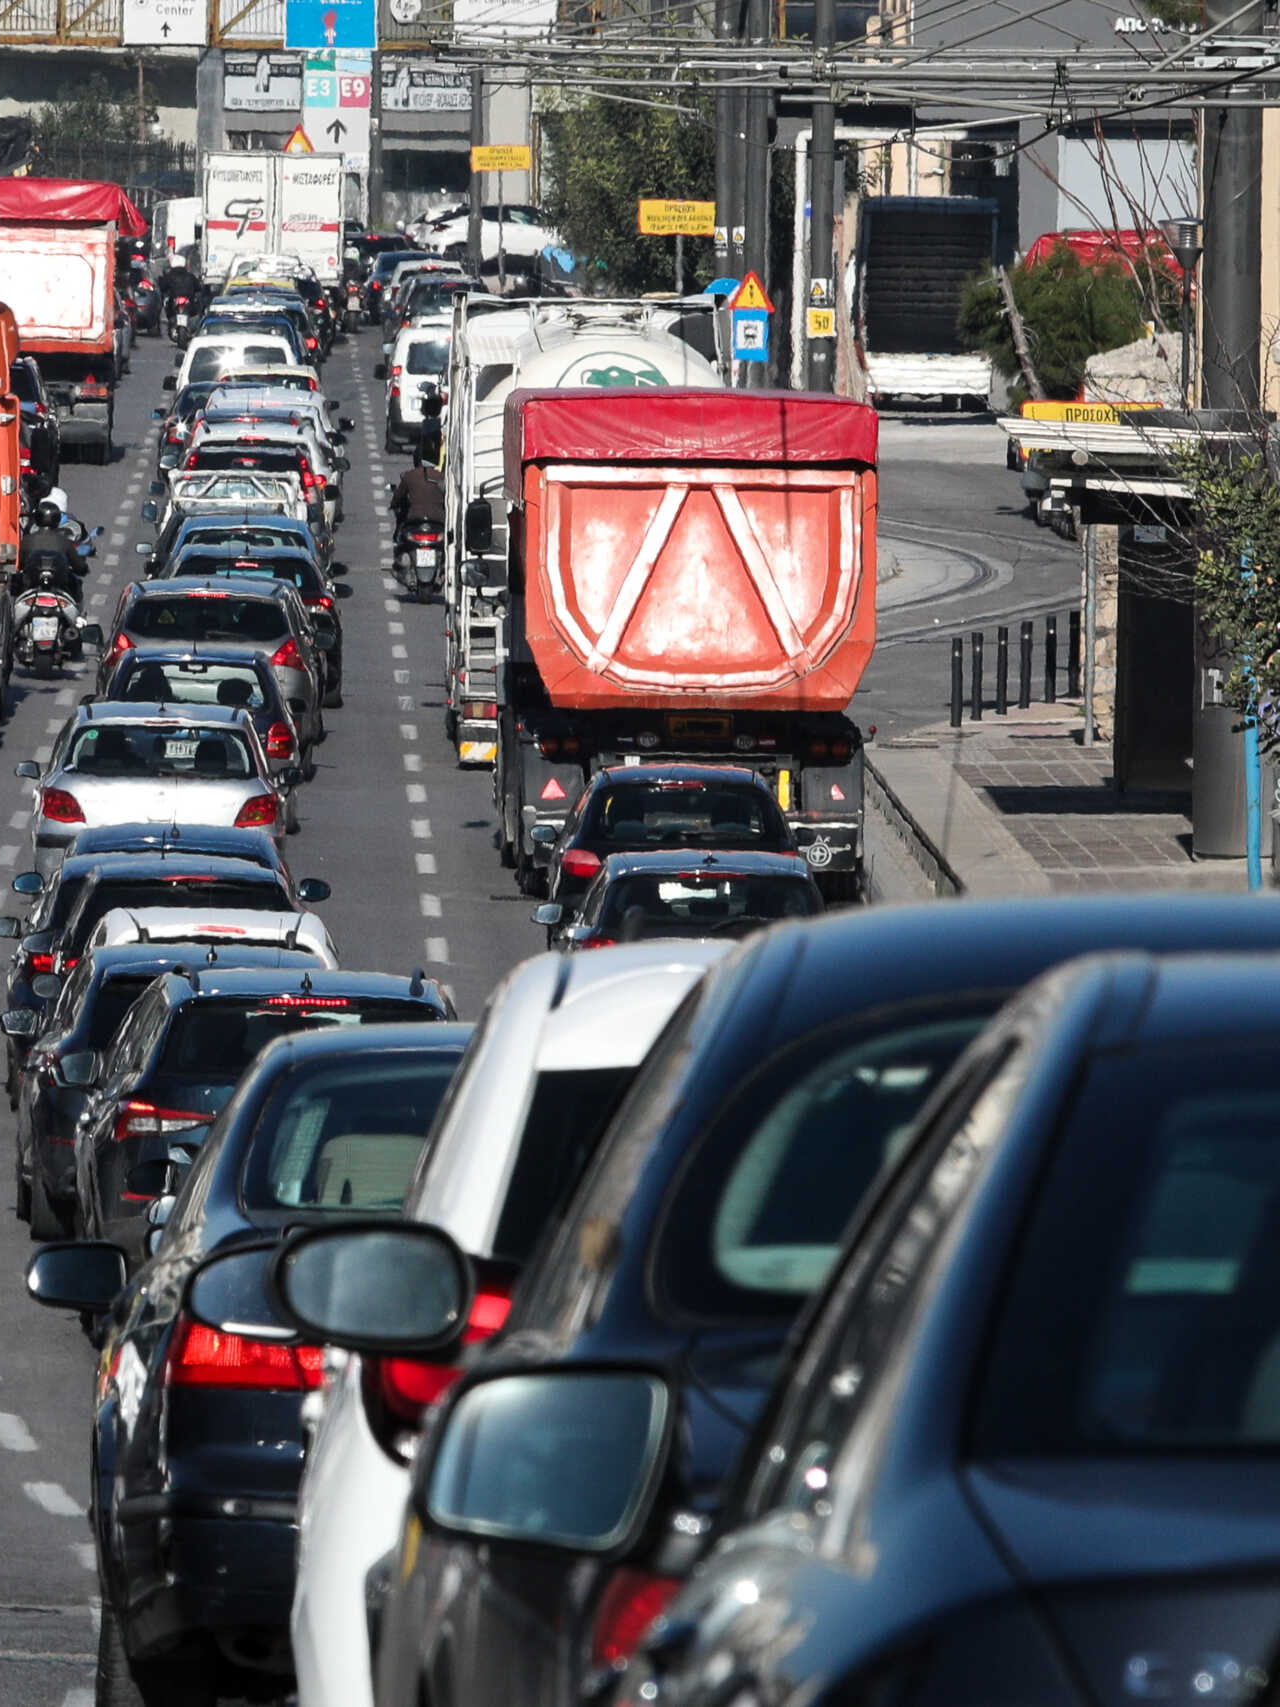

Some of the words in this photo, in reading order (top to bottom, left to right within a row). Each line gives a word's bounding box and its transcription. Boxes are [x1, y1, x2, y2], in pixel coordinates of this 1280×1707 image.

[156, 4, 194, 16] Center
[307, 79, 331, 97] E3
[341, 79, 366, 98] E9
[1065, 407, 1121, 423] ΠΡΟΣΟΧΗ
